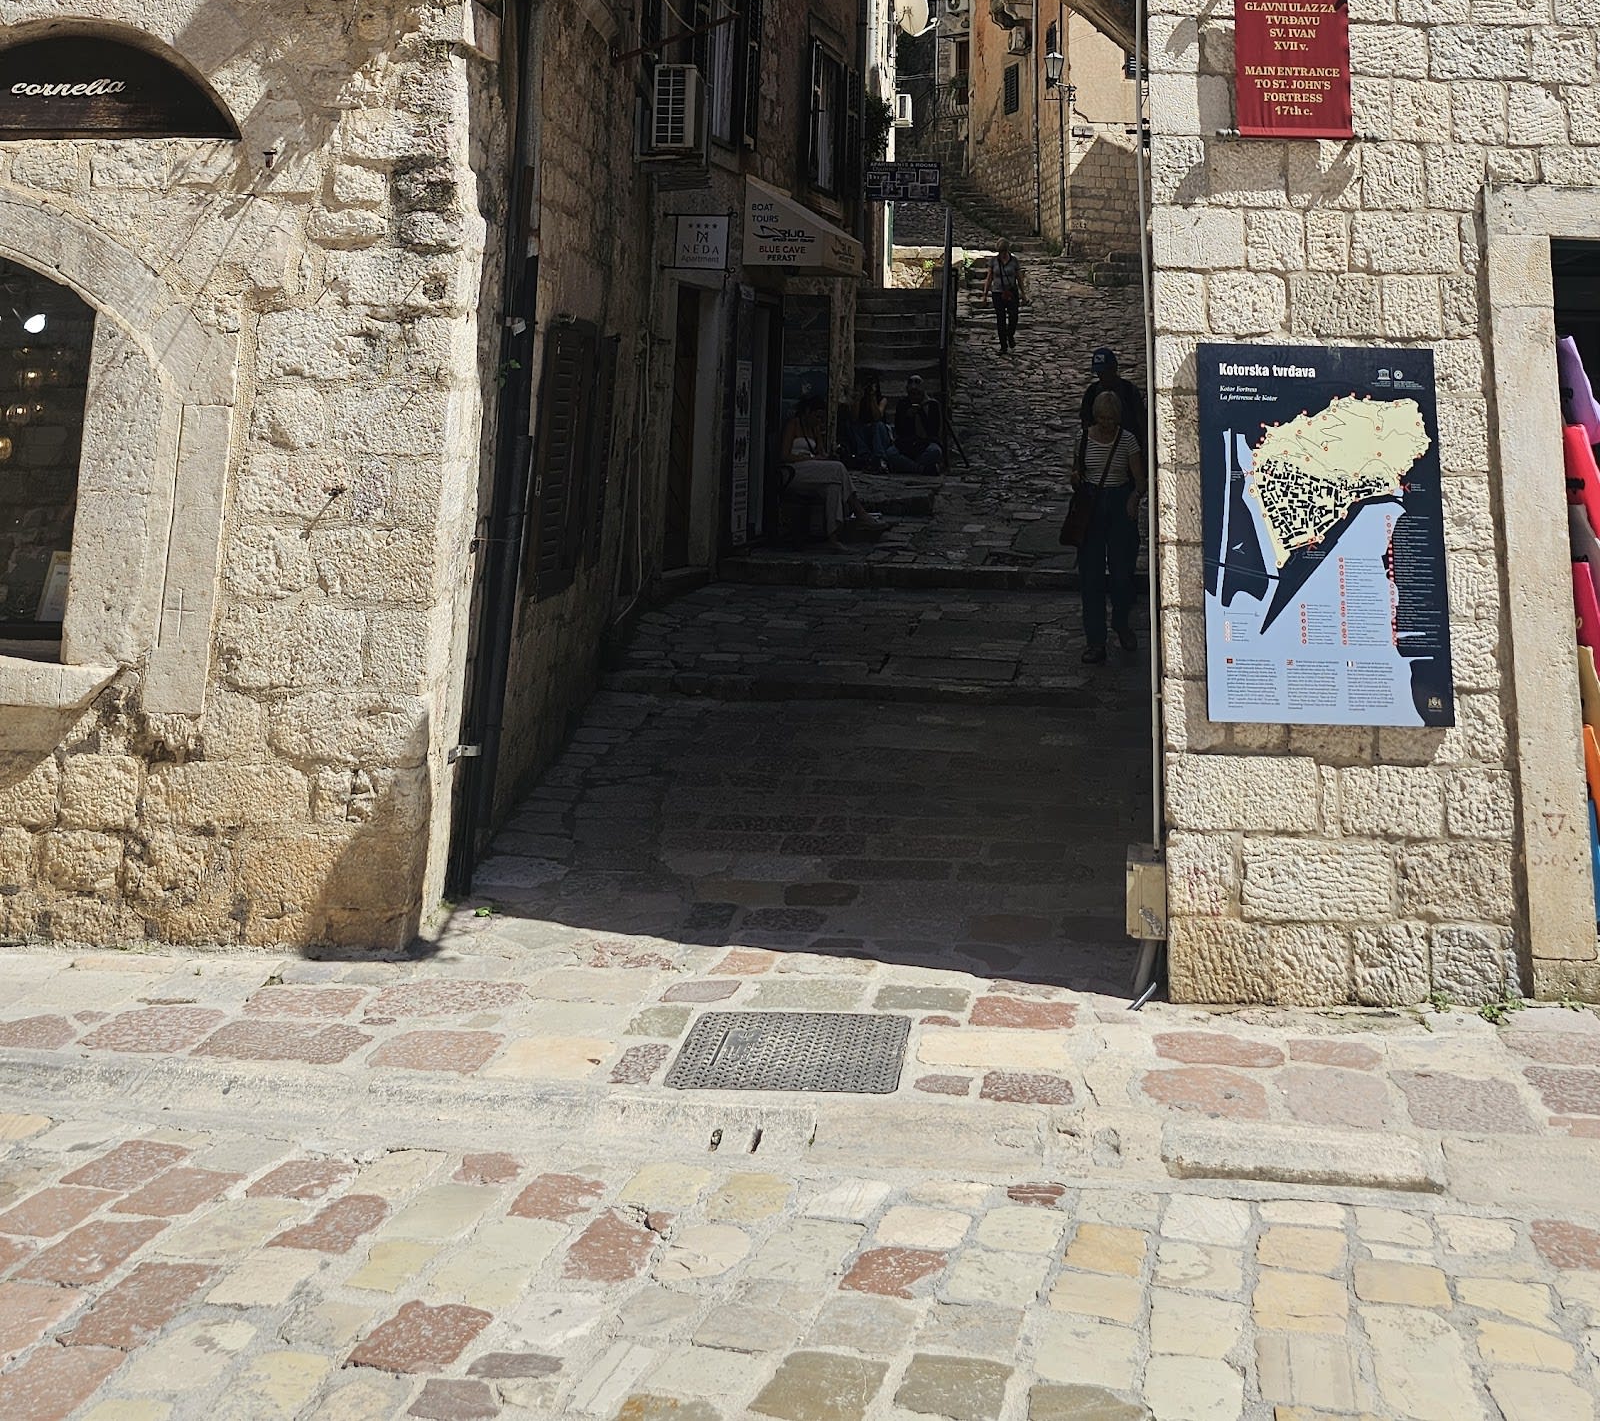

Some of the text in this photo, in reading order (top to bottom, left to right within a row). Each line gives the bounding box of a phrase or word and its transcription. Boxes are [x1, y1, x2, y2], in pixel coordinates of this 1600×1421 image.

[1244, 2, 1336, 13] GLAVNI ULAZ ZA
[1265, 15, 1320, 25] TVRĐAVU
[1269, 29, 1316, 38] SV. IVAN
[1274, 41, 1309, 51] XVII v.
[1244, 66, 1340, 77] MAIN ENTRANCE
[11, 78, 127, 97] cornelia
[1254, 79, 1331, 90] TO ST. JOHN'S
[1263, 92, 1323, 103] FORTRESS
[1275, 105, 1313, 116] 17th c.
[751, 203, 774, 211] BOAT
[751, 214, 779, 223] TOURS
[682, 244, 719, 255] NEDA
[759, 245, 806, 254] BLUE CAVE
[681, 255, 720, 264] Apartment
[767, 254, 797, 262] PERAST
[1219, 363, 1316, 378] Kotorska tvrđava
